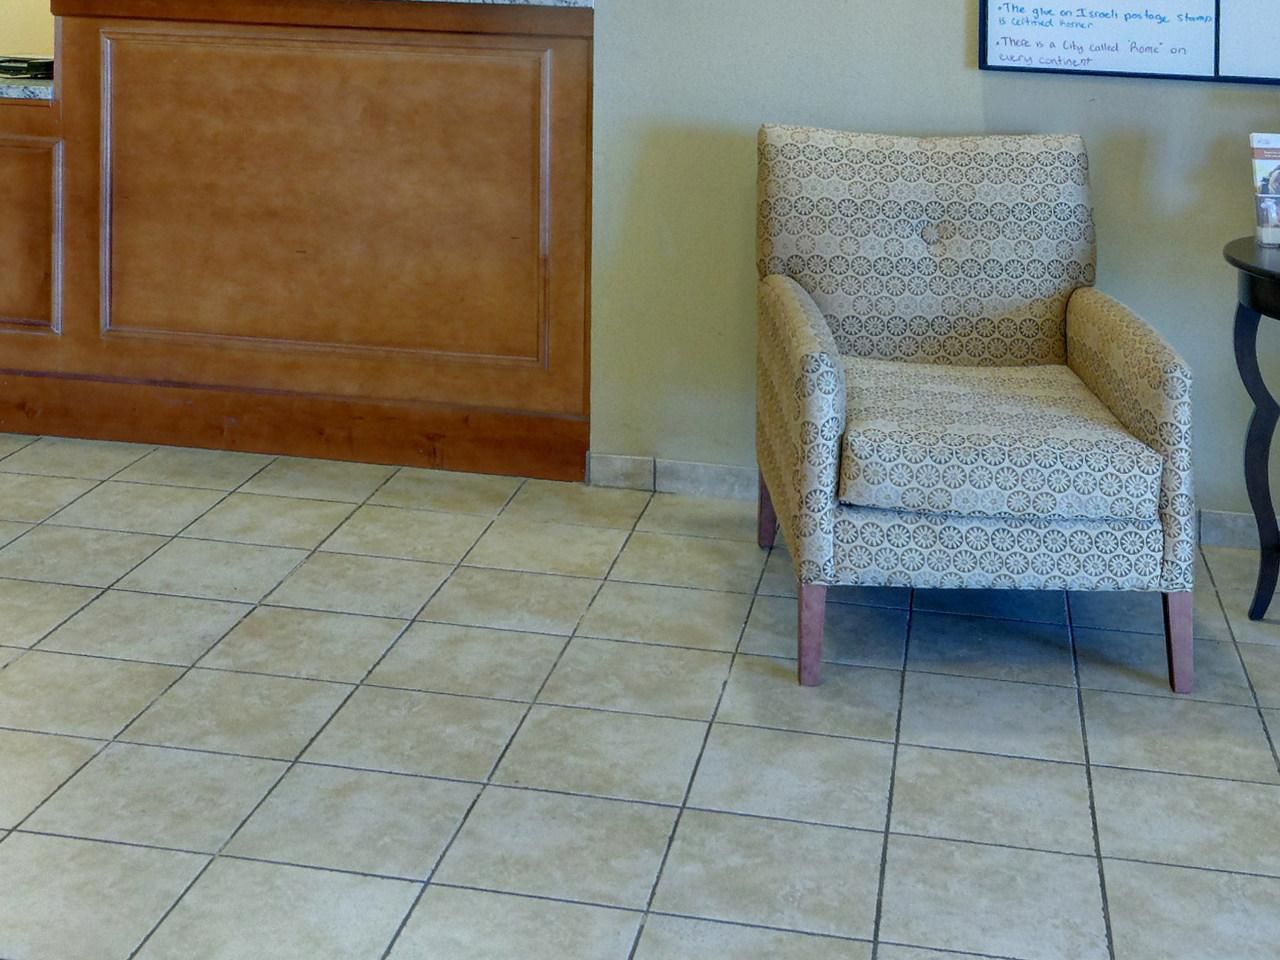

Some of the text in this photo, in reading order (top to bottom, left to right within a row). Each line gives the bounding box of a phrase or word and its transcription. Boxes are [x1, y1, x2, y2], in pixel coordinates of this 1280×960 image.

[1032, 7, 1055, 20] glue
[1124, 10, 1170, 24] postage
[1089, 42, 1121, 53] called
[1169, 47, 1187, 55] on
[999, 54, 1094, 66] every continent
